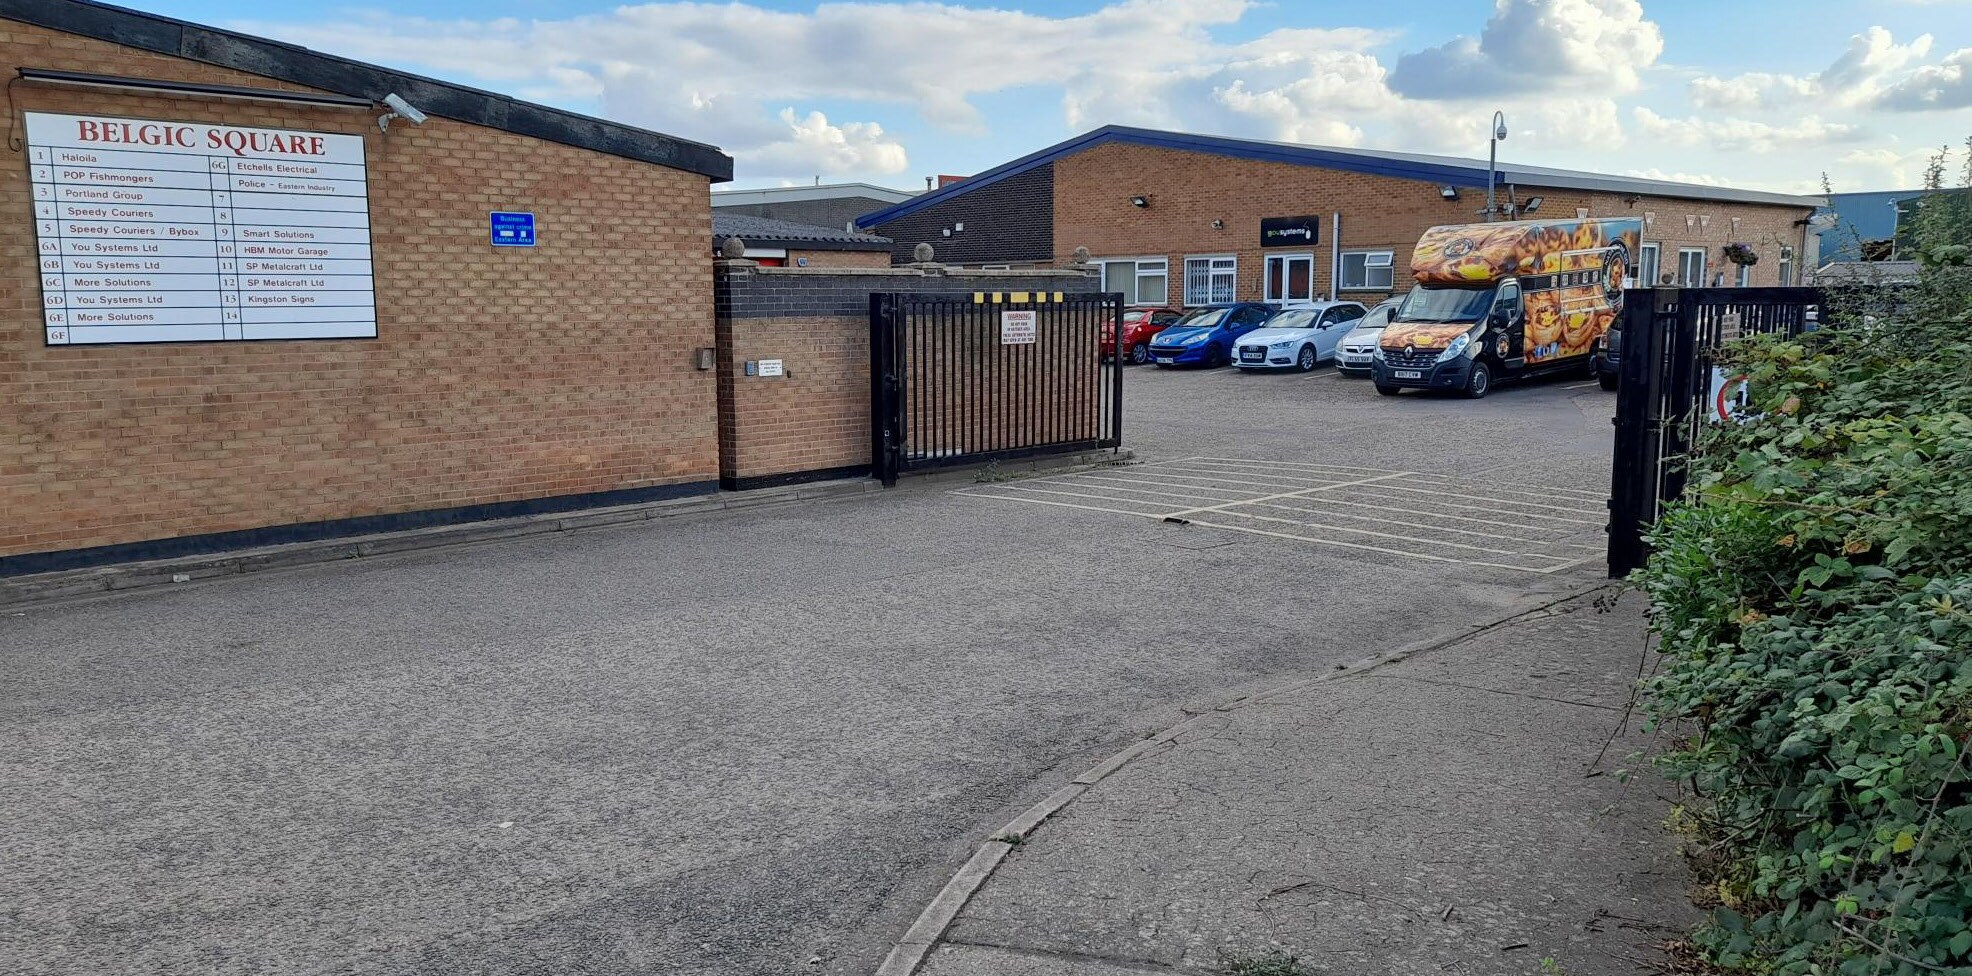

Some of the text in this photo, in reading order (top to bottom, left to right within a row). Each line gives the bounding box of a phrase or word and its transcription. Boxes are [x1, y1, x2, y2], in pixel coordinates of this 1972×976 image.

[77, 120, 326, 156] BELGIC SQUARE
[62, 153, 97, 162] Haloila
[211, 160, 318, 174] 6G Etchells Electrical
[39, 170, 154, 183] 2 POP Fishmongers
[238, 179, 266, 188] Police
[278, 182, 305, 190] Eastern
[308, 184, 335, 192] Industry
[40, 187, 143, 201] 3 Portland Group
[42, 207, 154, 218] 4 Speedy Couriers
[45, 225, 51, 233] 5
[69, 225, 109, 235] Speedy
[113, 226, 155, 235] Couriers
[169, 228, 199, 237] Bybox
[243, 229, 270, 238] Smart
[274, 230, 315, 239] Solutions
[42, 242, 158, 253] 6A You Systems Ltd
[220, 245, 328, 257] 10 HBM Motor Garage
[43, 260, 160, 271] 6B You Systems Ltd
[222, 262, 233, 270] 11
[246, 263, 258, 271] SP
[261, 263, 306, 271] Metalcraft
[45, 278, 151, 287] 6C More Solutions
[223, 278, 325, 287] 12 SP Metalcraft Ltd
[46, 296, 163, 305] 6D You Systems Ltd
[225, 295, 315, 305] 13 Kingston Signs
[49, 313, 154, 322] 6E More Solutions
[226, 311, 238, 320] 14
[51, 331, 66, 340] 6F
